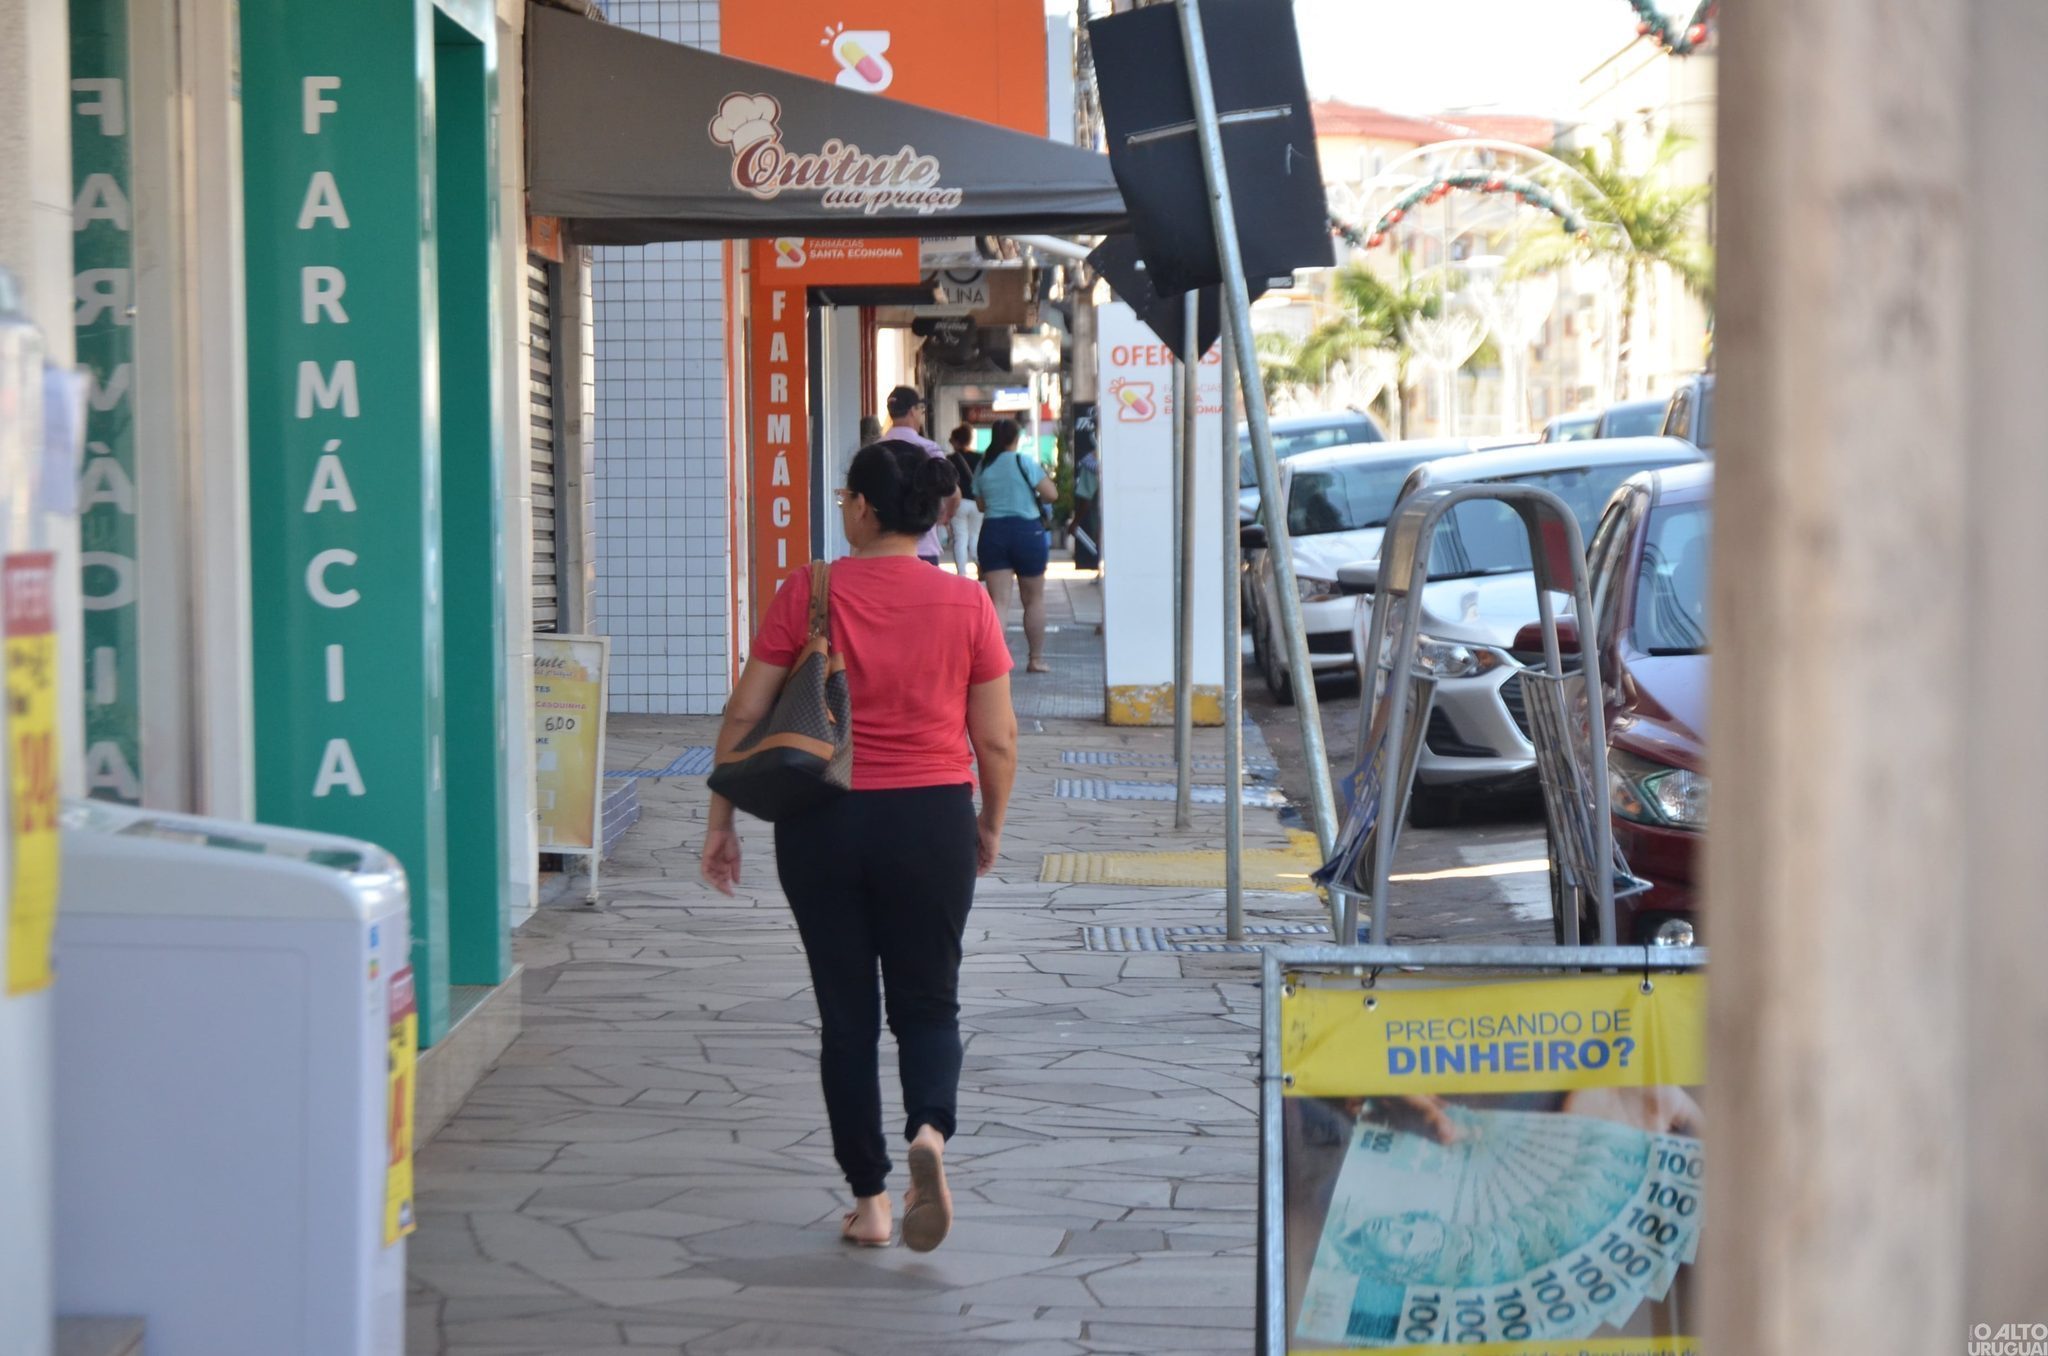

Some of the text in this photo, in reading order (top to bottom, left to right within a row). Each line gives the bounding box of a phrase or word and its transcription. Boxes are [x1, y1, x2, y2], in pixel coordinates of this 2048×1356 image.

[733, 137, 940, 198] Quitute
[809, 248, 903, 258] SANTA ECONOMIA
[944, 287, 985, 304] LINA
[1111, 343, 1222, 367] OFERS
[297, 75, 367, 798] FARMÁCIA
[767, 289, 791, 593] FARMÁCI
[1385, 1008, 1633, 1042] PRECISANDO DE
[1387, 1036, 1636, 1076] DINHEIRO?
[1647, 1181, 1697, 1217] 100
[1627, 1207, 1679, 1246] 100
[1601, 1233, 1652, 1277] 100
[1531, 1270, 1576, 1324] 100
[1568, 1254, 1617, 1304] 100
[1404, 1293, 1441, 1344] 100
[1494, 1287, 1532, 1341] 100
